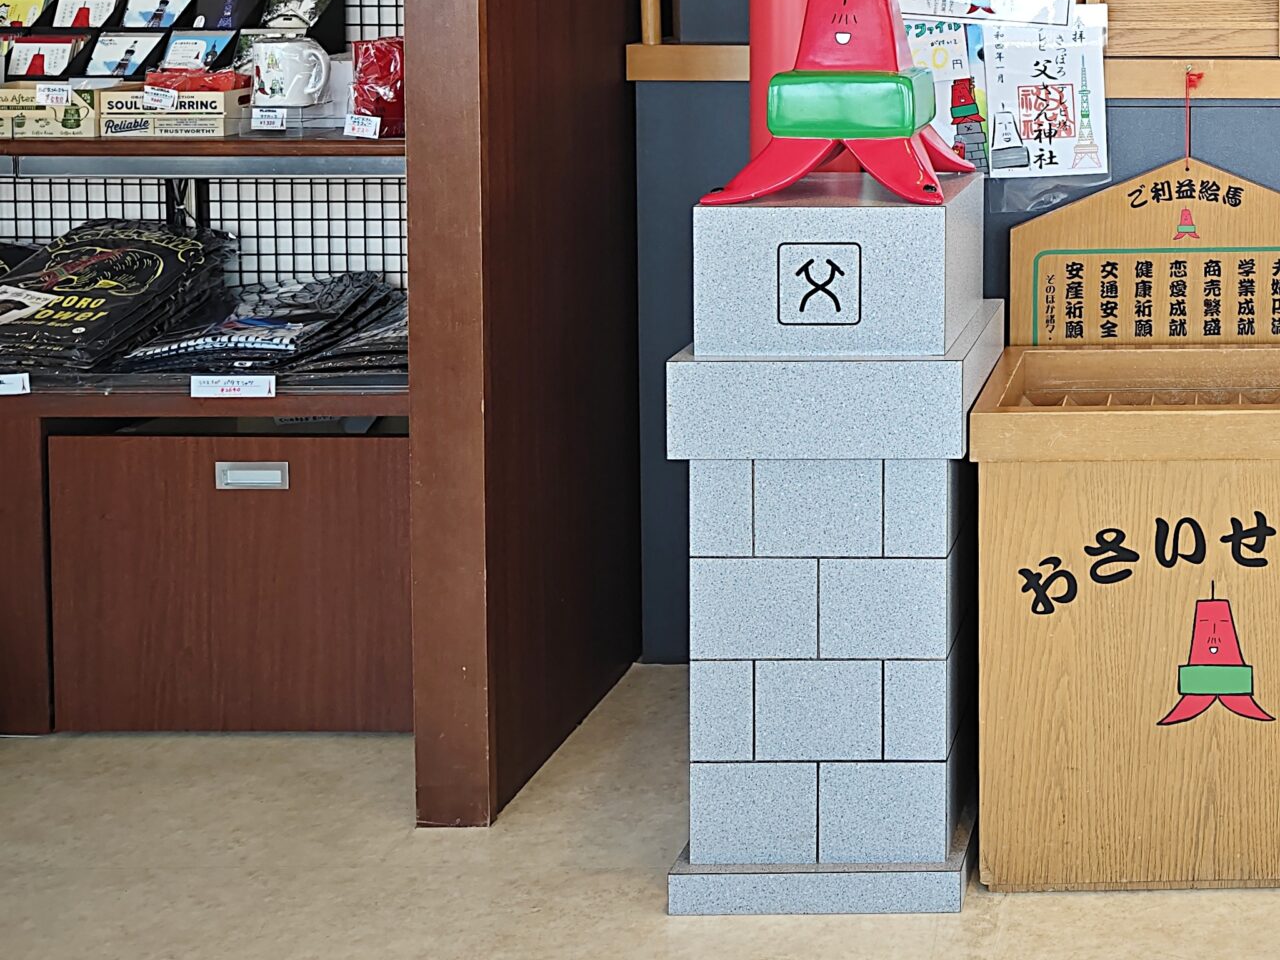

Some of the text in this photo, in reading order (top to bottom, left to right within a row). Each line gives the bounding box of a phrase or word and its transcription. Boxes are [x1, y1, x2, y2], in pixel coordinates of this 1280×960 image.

[993, 24, 1005, 83] 和四年一月
[104, 118, 150, 134] Reliable
[107, 100, 140, 110] SOUL
[1031, 27, 1059, 170] レビ父さん神社
[1127, 179, 1245, 209] ご利益絵馬
[34, 309, 109, 321] ower
[1065, 261, 1084, 339] 安産祈願
[1100, 261, 1119, 338] 交通安全
[1134, 260, 1153, 338] 健康祈願
[1169, 259, 1188, 337] 恋愛成就
[1203, 258, 1222, 337] 商売繁盛
[1237, 258, 1256, 336] 学業成就
